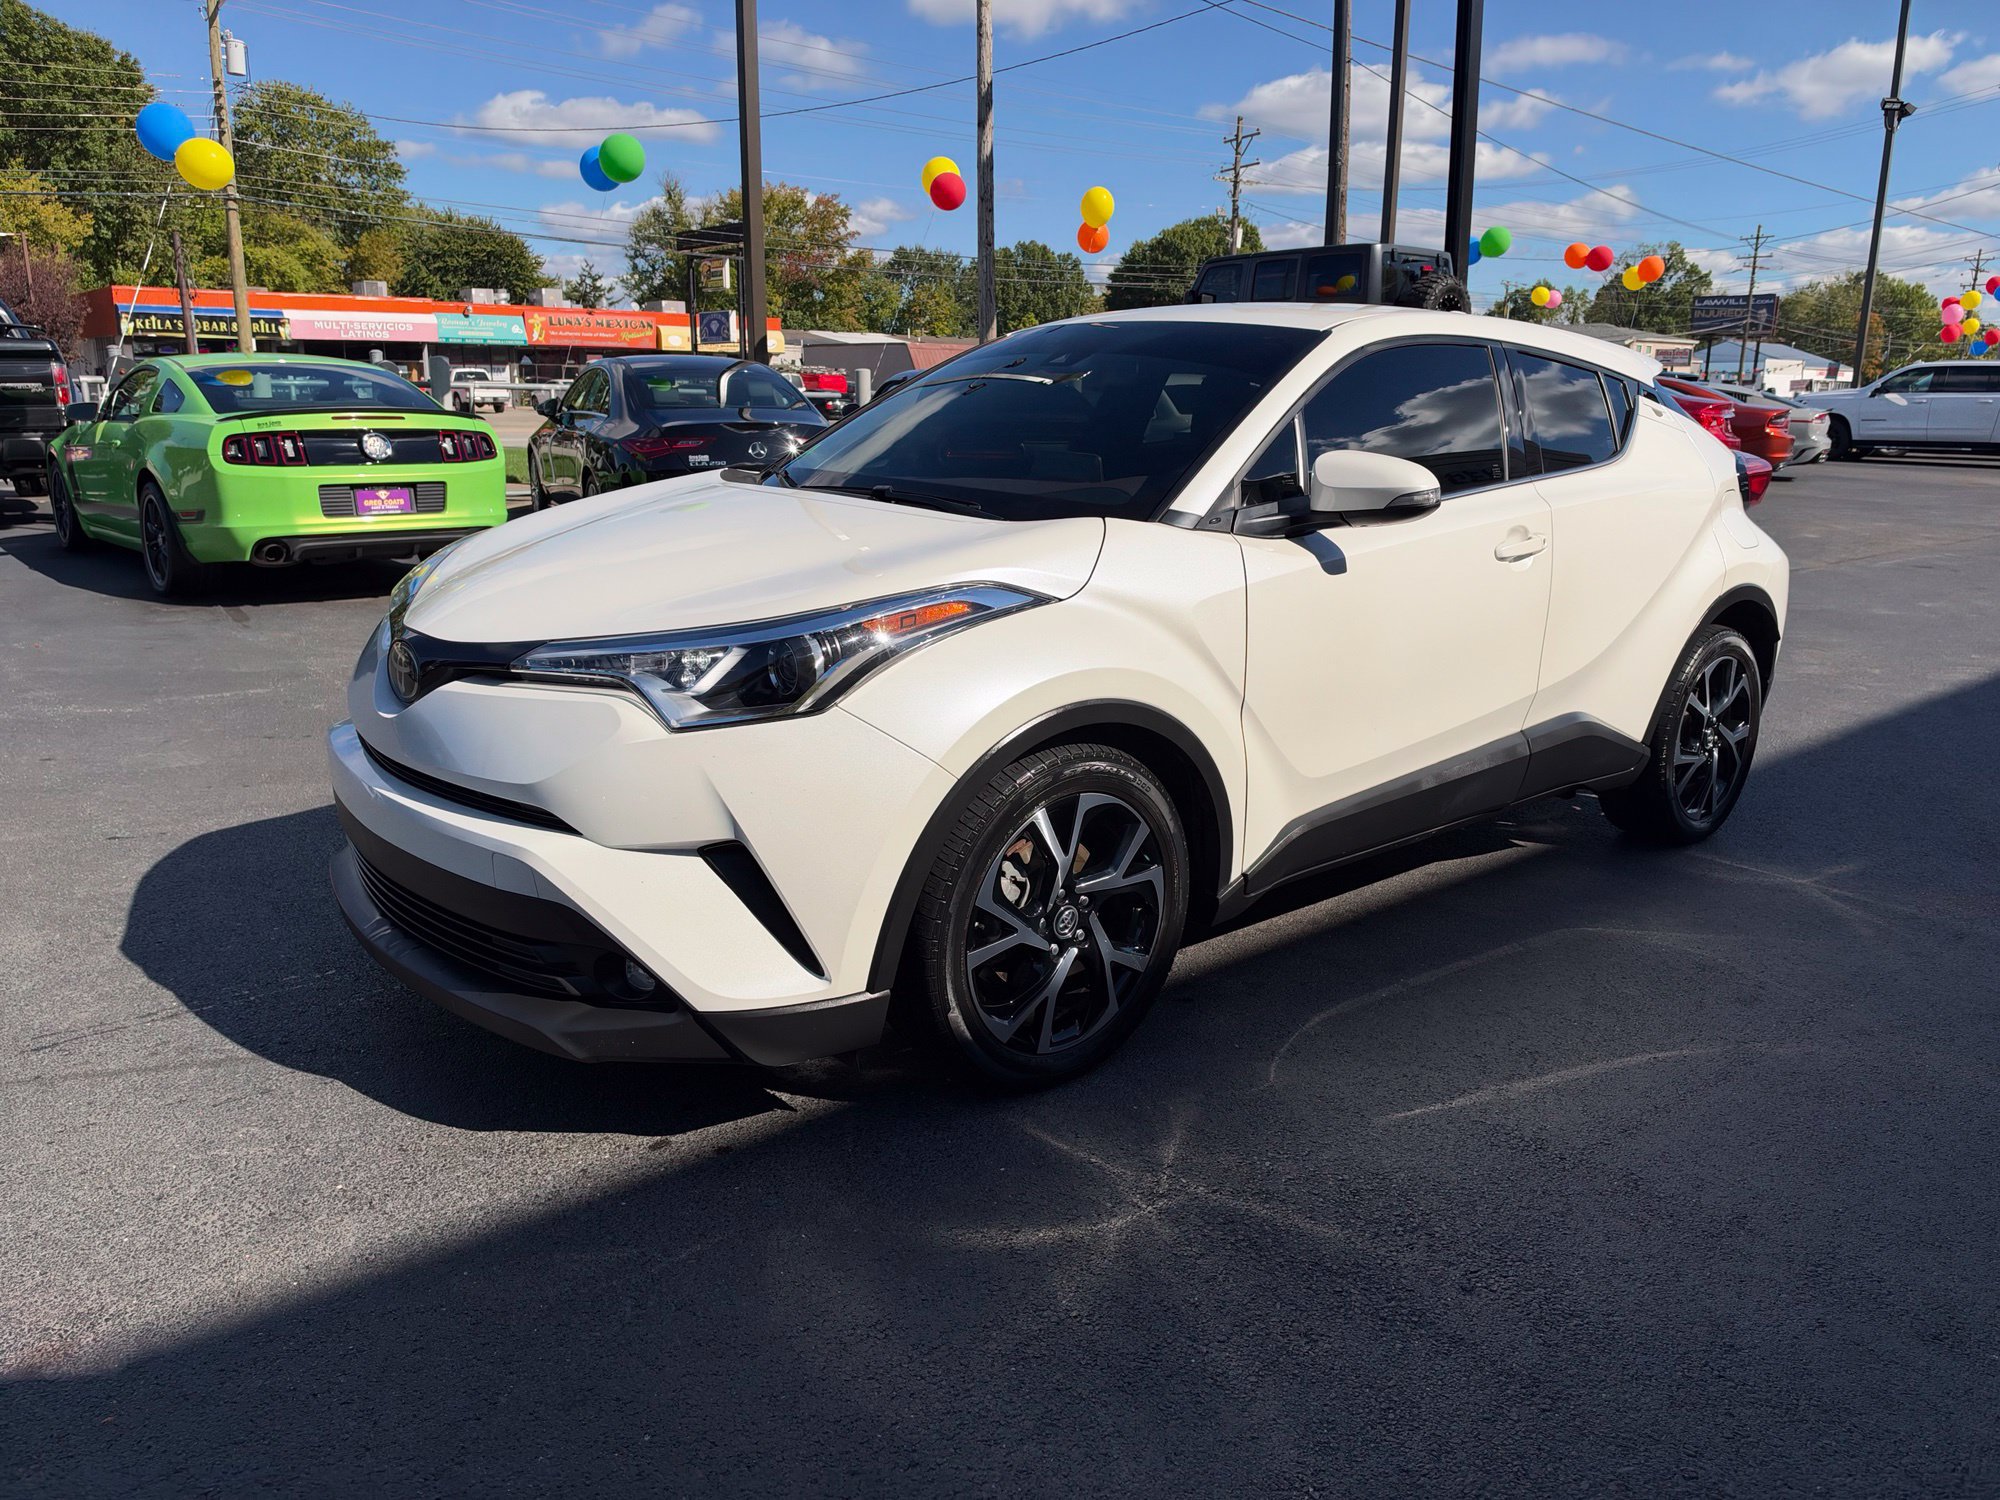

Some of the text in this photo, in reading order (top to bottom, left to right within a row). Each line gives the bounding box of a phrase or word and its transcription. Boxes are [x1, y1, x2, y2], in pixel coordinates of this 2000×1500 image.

[136, 315, 184, 330] KEILA'S
[205, 321, 228, 331] BAR
[252, 319, 278, 334] RILL
[314, 321, 413, 331] MULTI-SERVICIOS
[548, 316, 654, 330] LUNA'S MEXICAN
[340, 330, 390, 339] LATINOS
